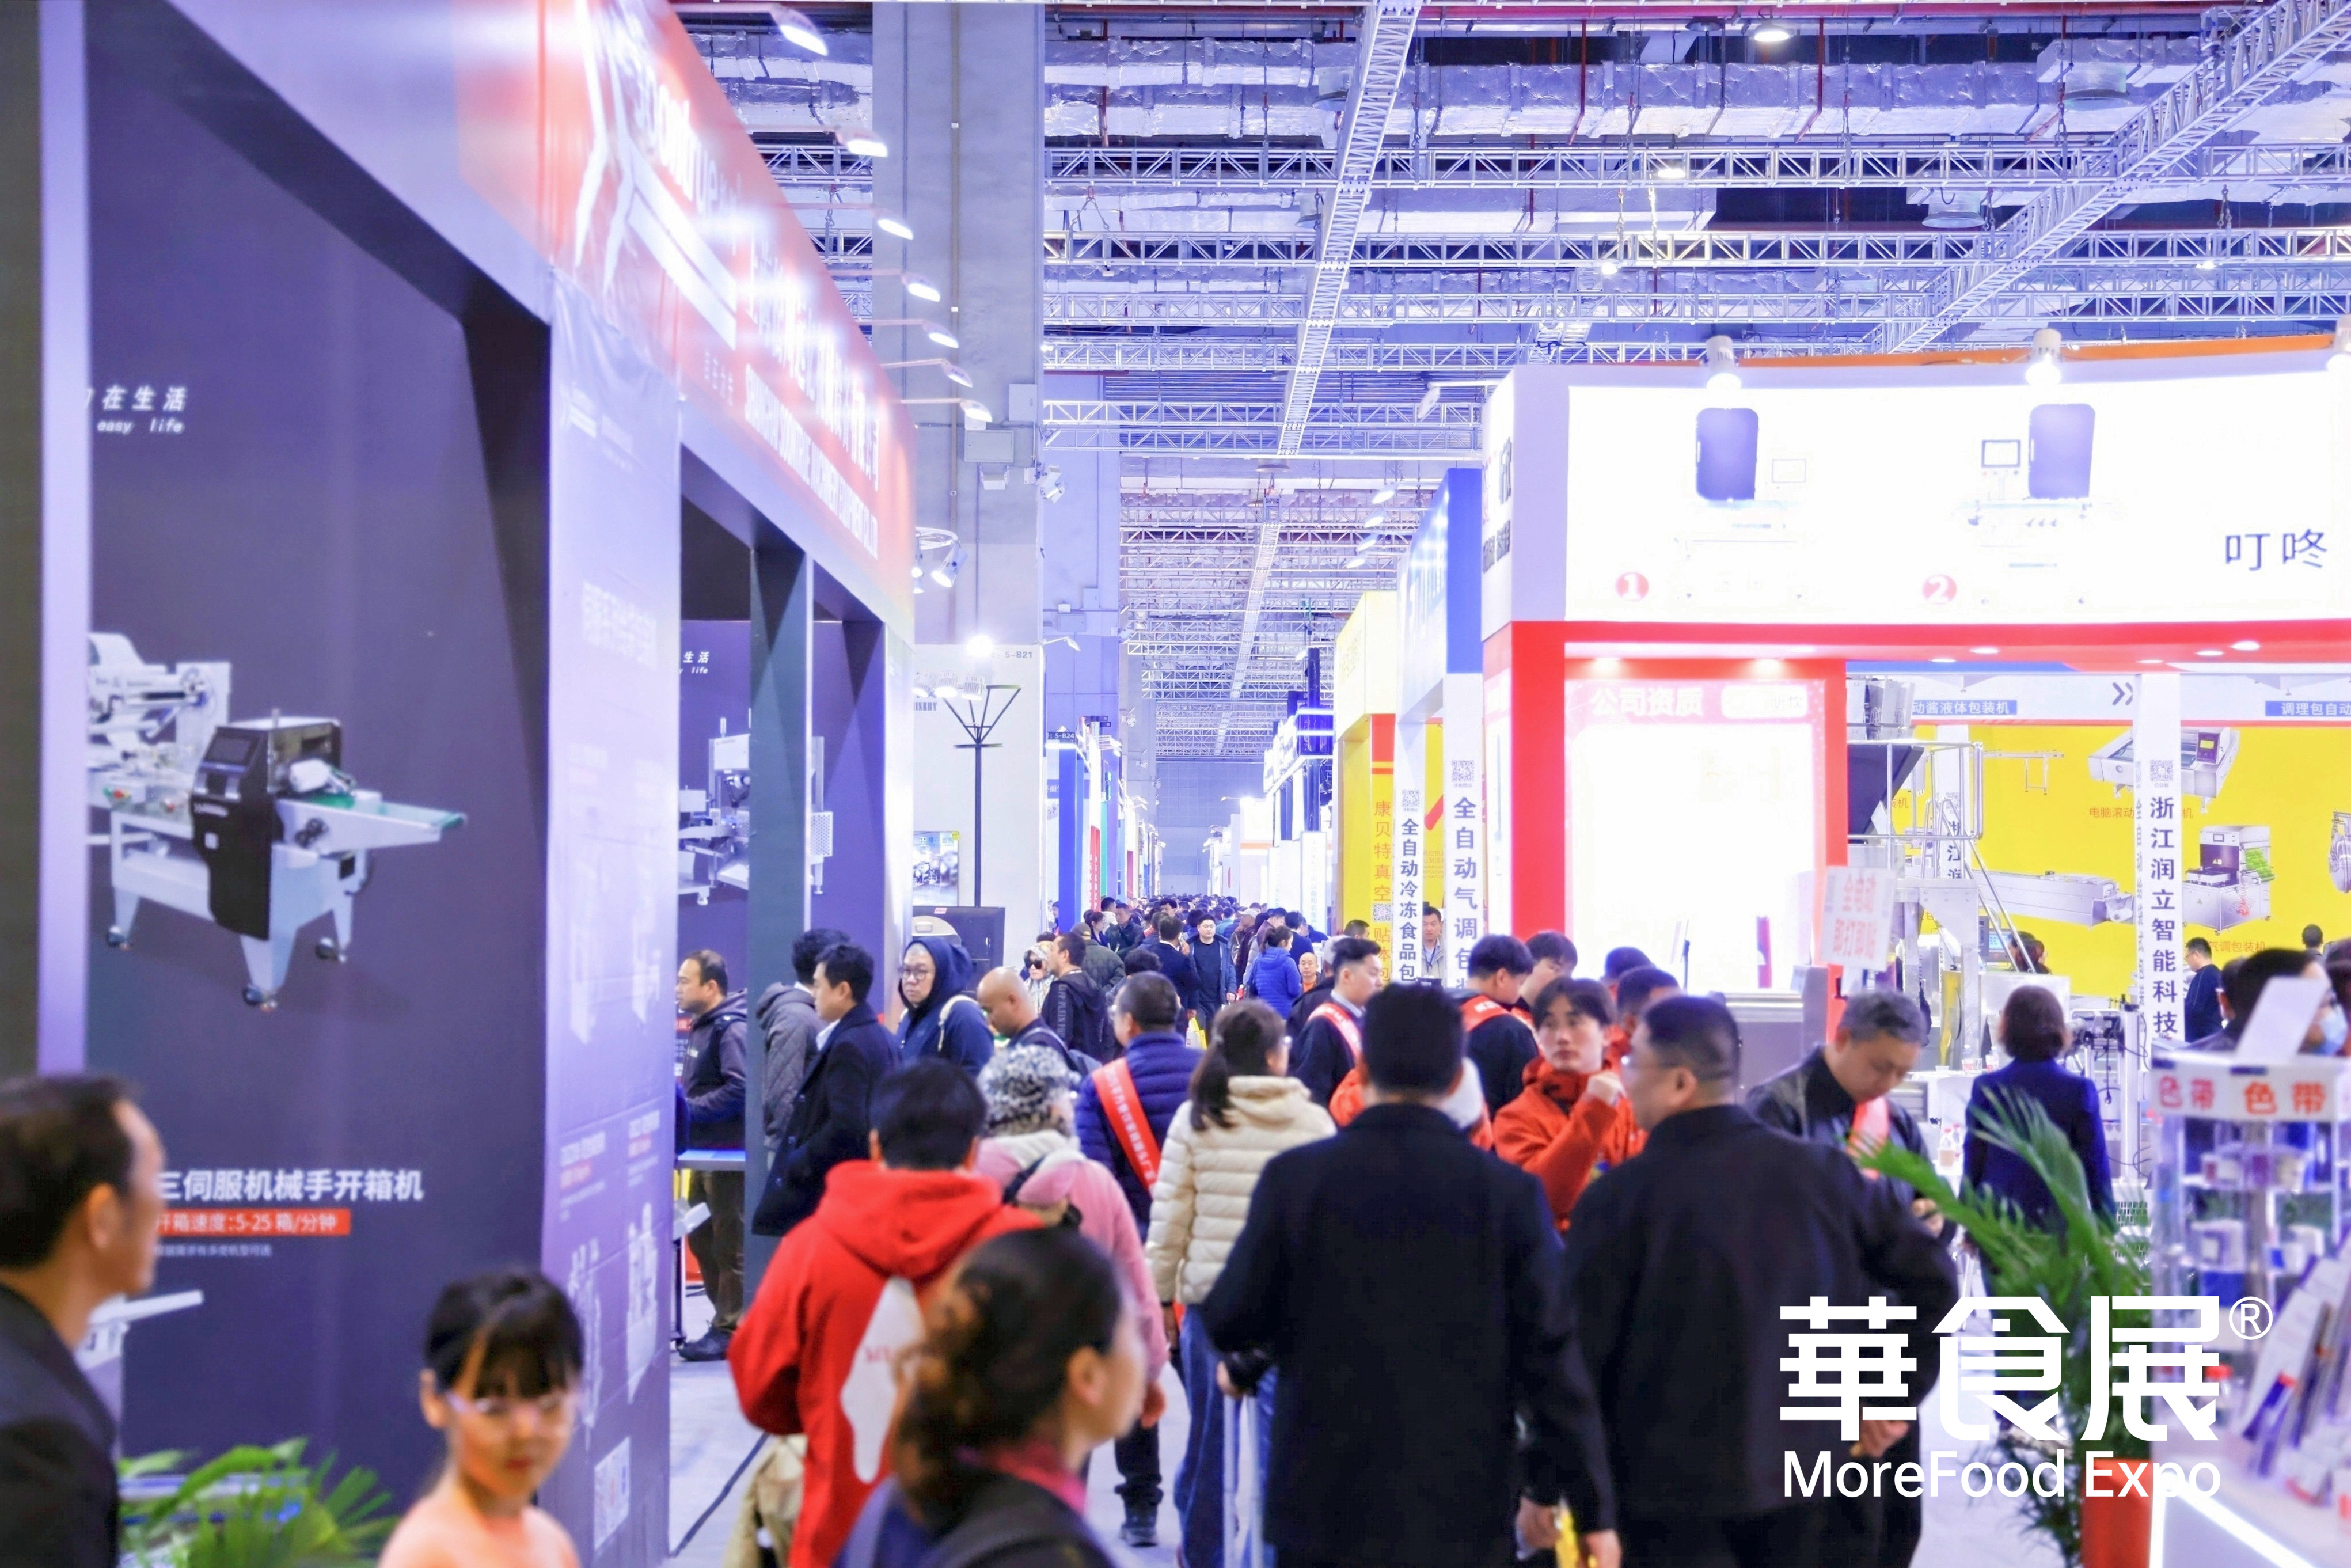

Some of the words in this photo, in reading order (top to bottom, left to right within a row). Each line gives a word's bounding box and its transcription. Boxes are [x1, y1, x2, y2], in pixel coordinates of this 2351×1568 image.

[97, 420, 135, 436] easy
[150, 417, 186, 434] life
[2225, 528, 2328, 571] 叮咚
[683, 651, 710, 663] 生活
[691, 666, 709, 674] life
[1005, 651, 1032, 659] 5-B21
[1373, 800, 1392, 902] 康贝特真空
[1398, 818, 1419, 982] 全自动冷冻食品包
[1453, 796, 1478, 990] 全自动气调包
[2149, 796, 2179, 1035] 浙江润立智能科技
[2244, 1080, 2326, 1115] 色带
